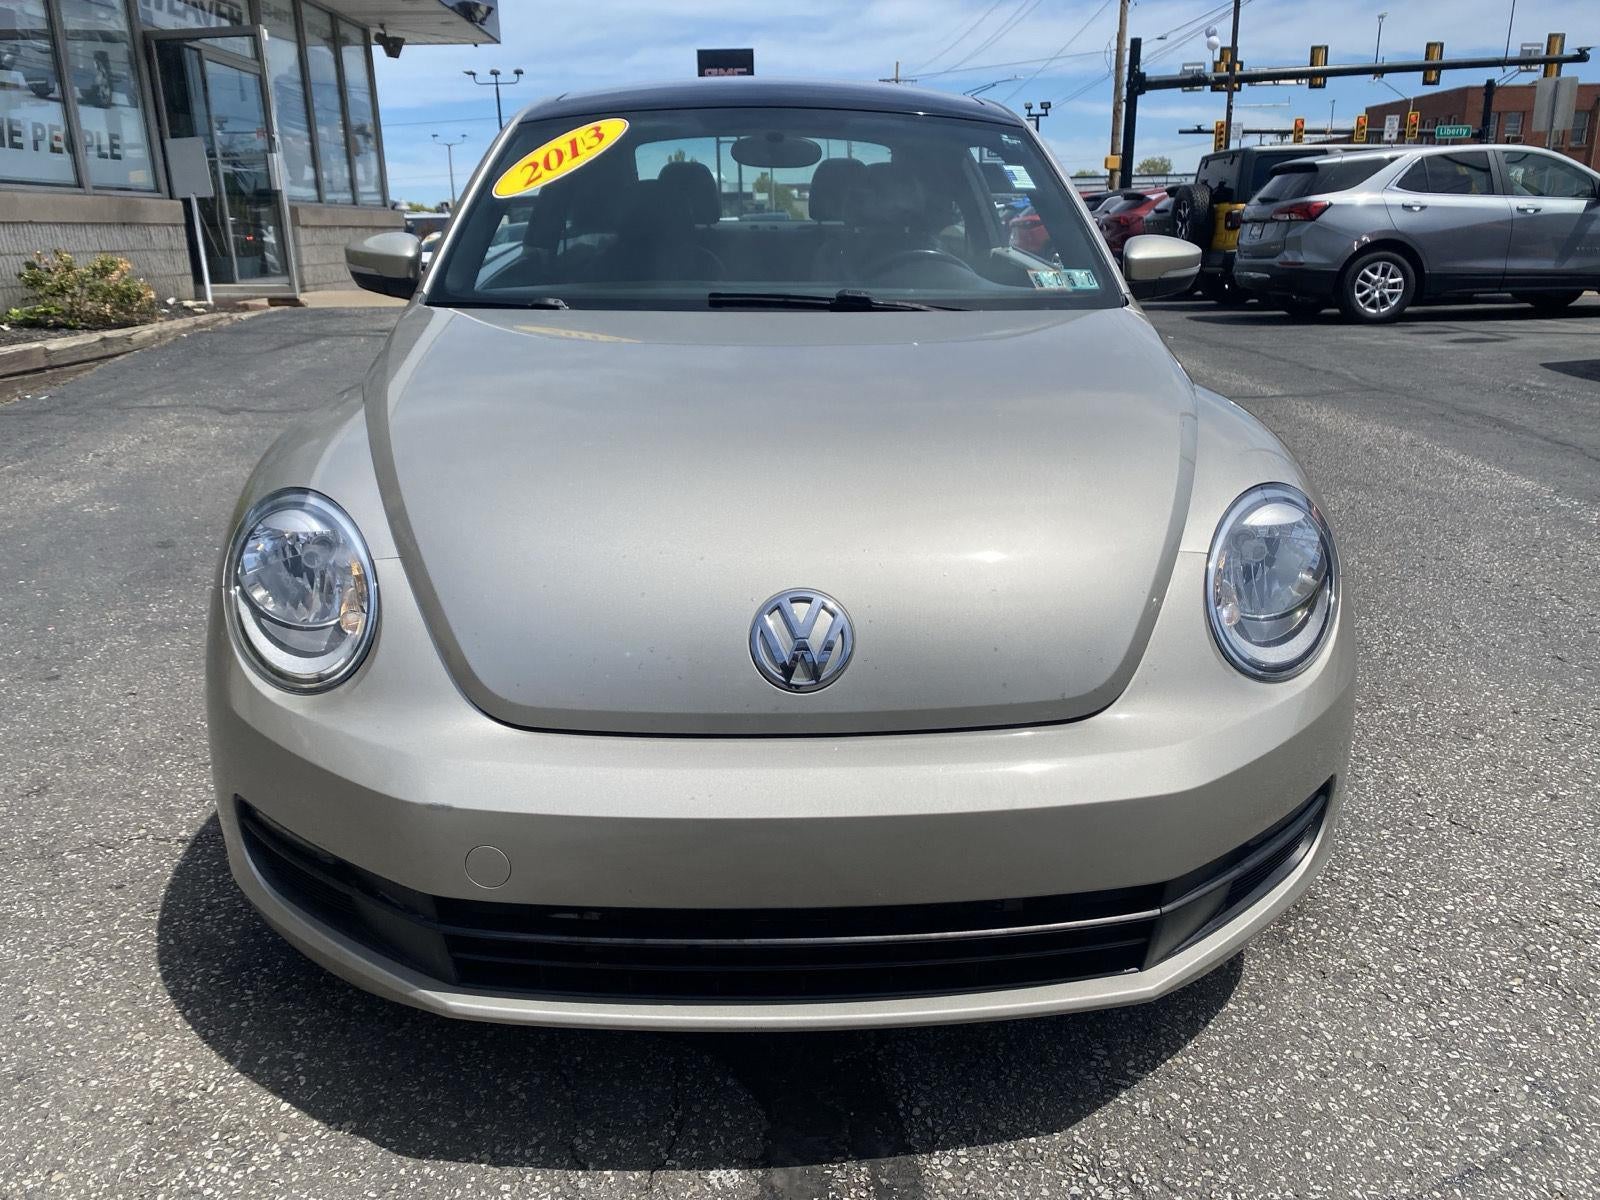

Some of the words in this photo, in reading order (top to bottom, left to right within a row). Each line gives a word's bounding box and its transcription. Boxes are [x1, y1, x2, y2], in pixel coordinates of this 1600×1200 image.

[31, 121, 122, 161] PEPLE
[1440, 127, 1468, 136] Liberty
[520, 126, 605, 187] 2013
